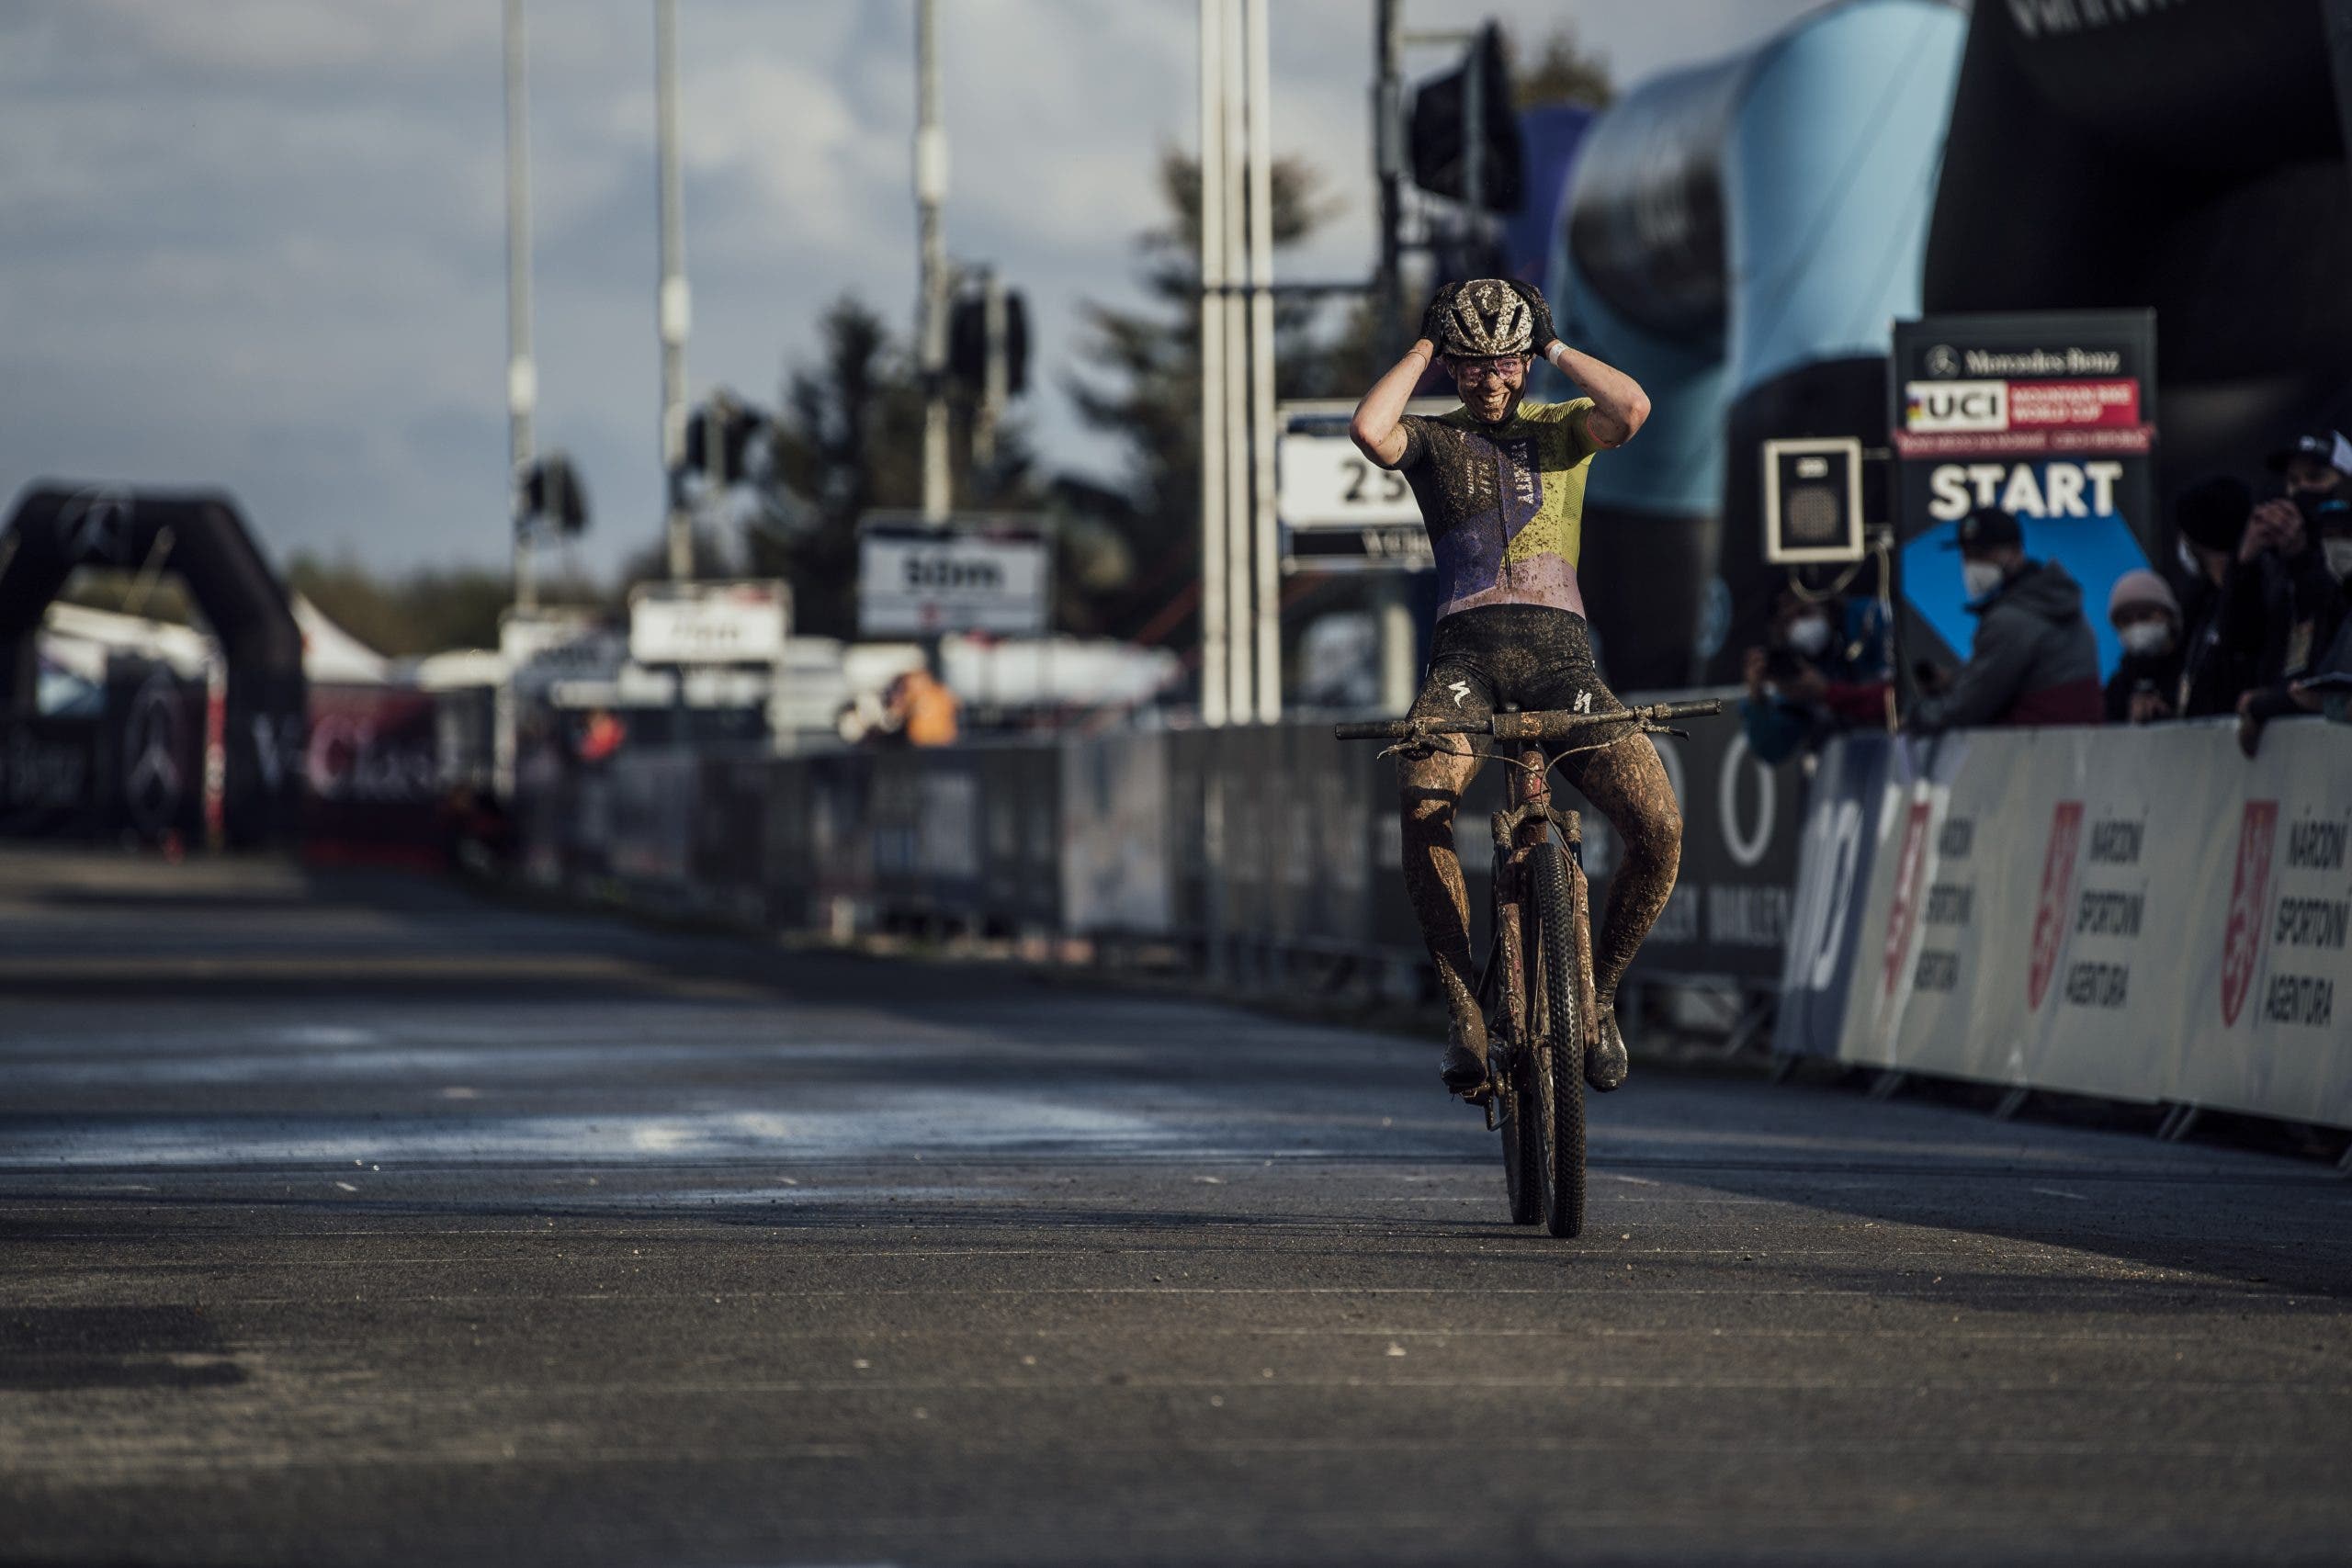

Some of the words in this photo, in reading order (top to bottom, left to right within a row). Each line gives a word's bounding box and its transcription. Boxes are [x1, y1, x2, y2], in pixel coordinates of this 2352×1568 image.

[1928, 391, 1997, 421] UCI
[1929, 462, 2123, 521] START
[2265, 972, 2334, 1027] AGENTURA
